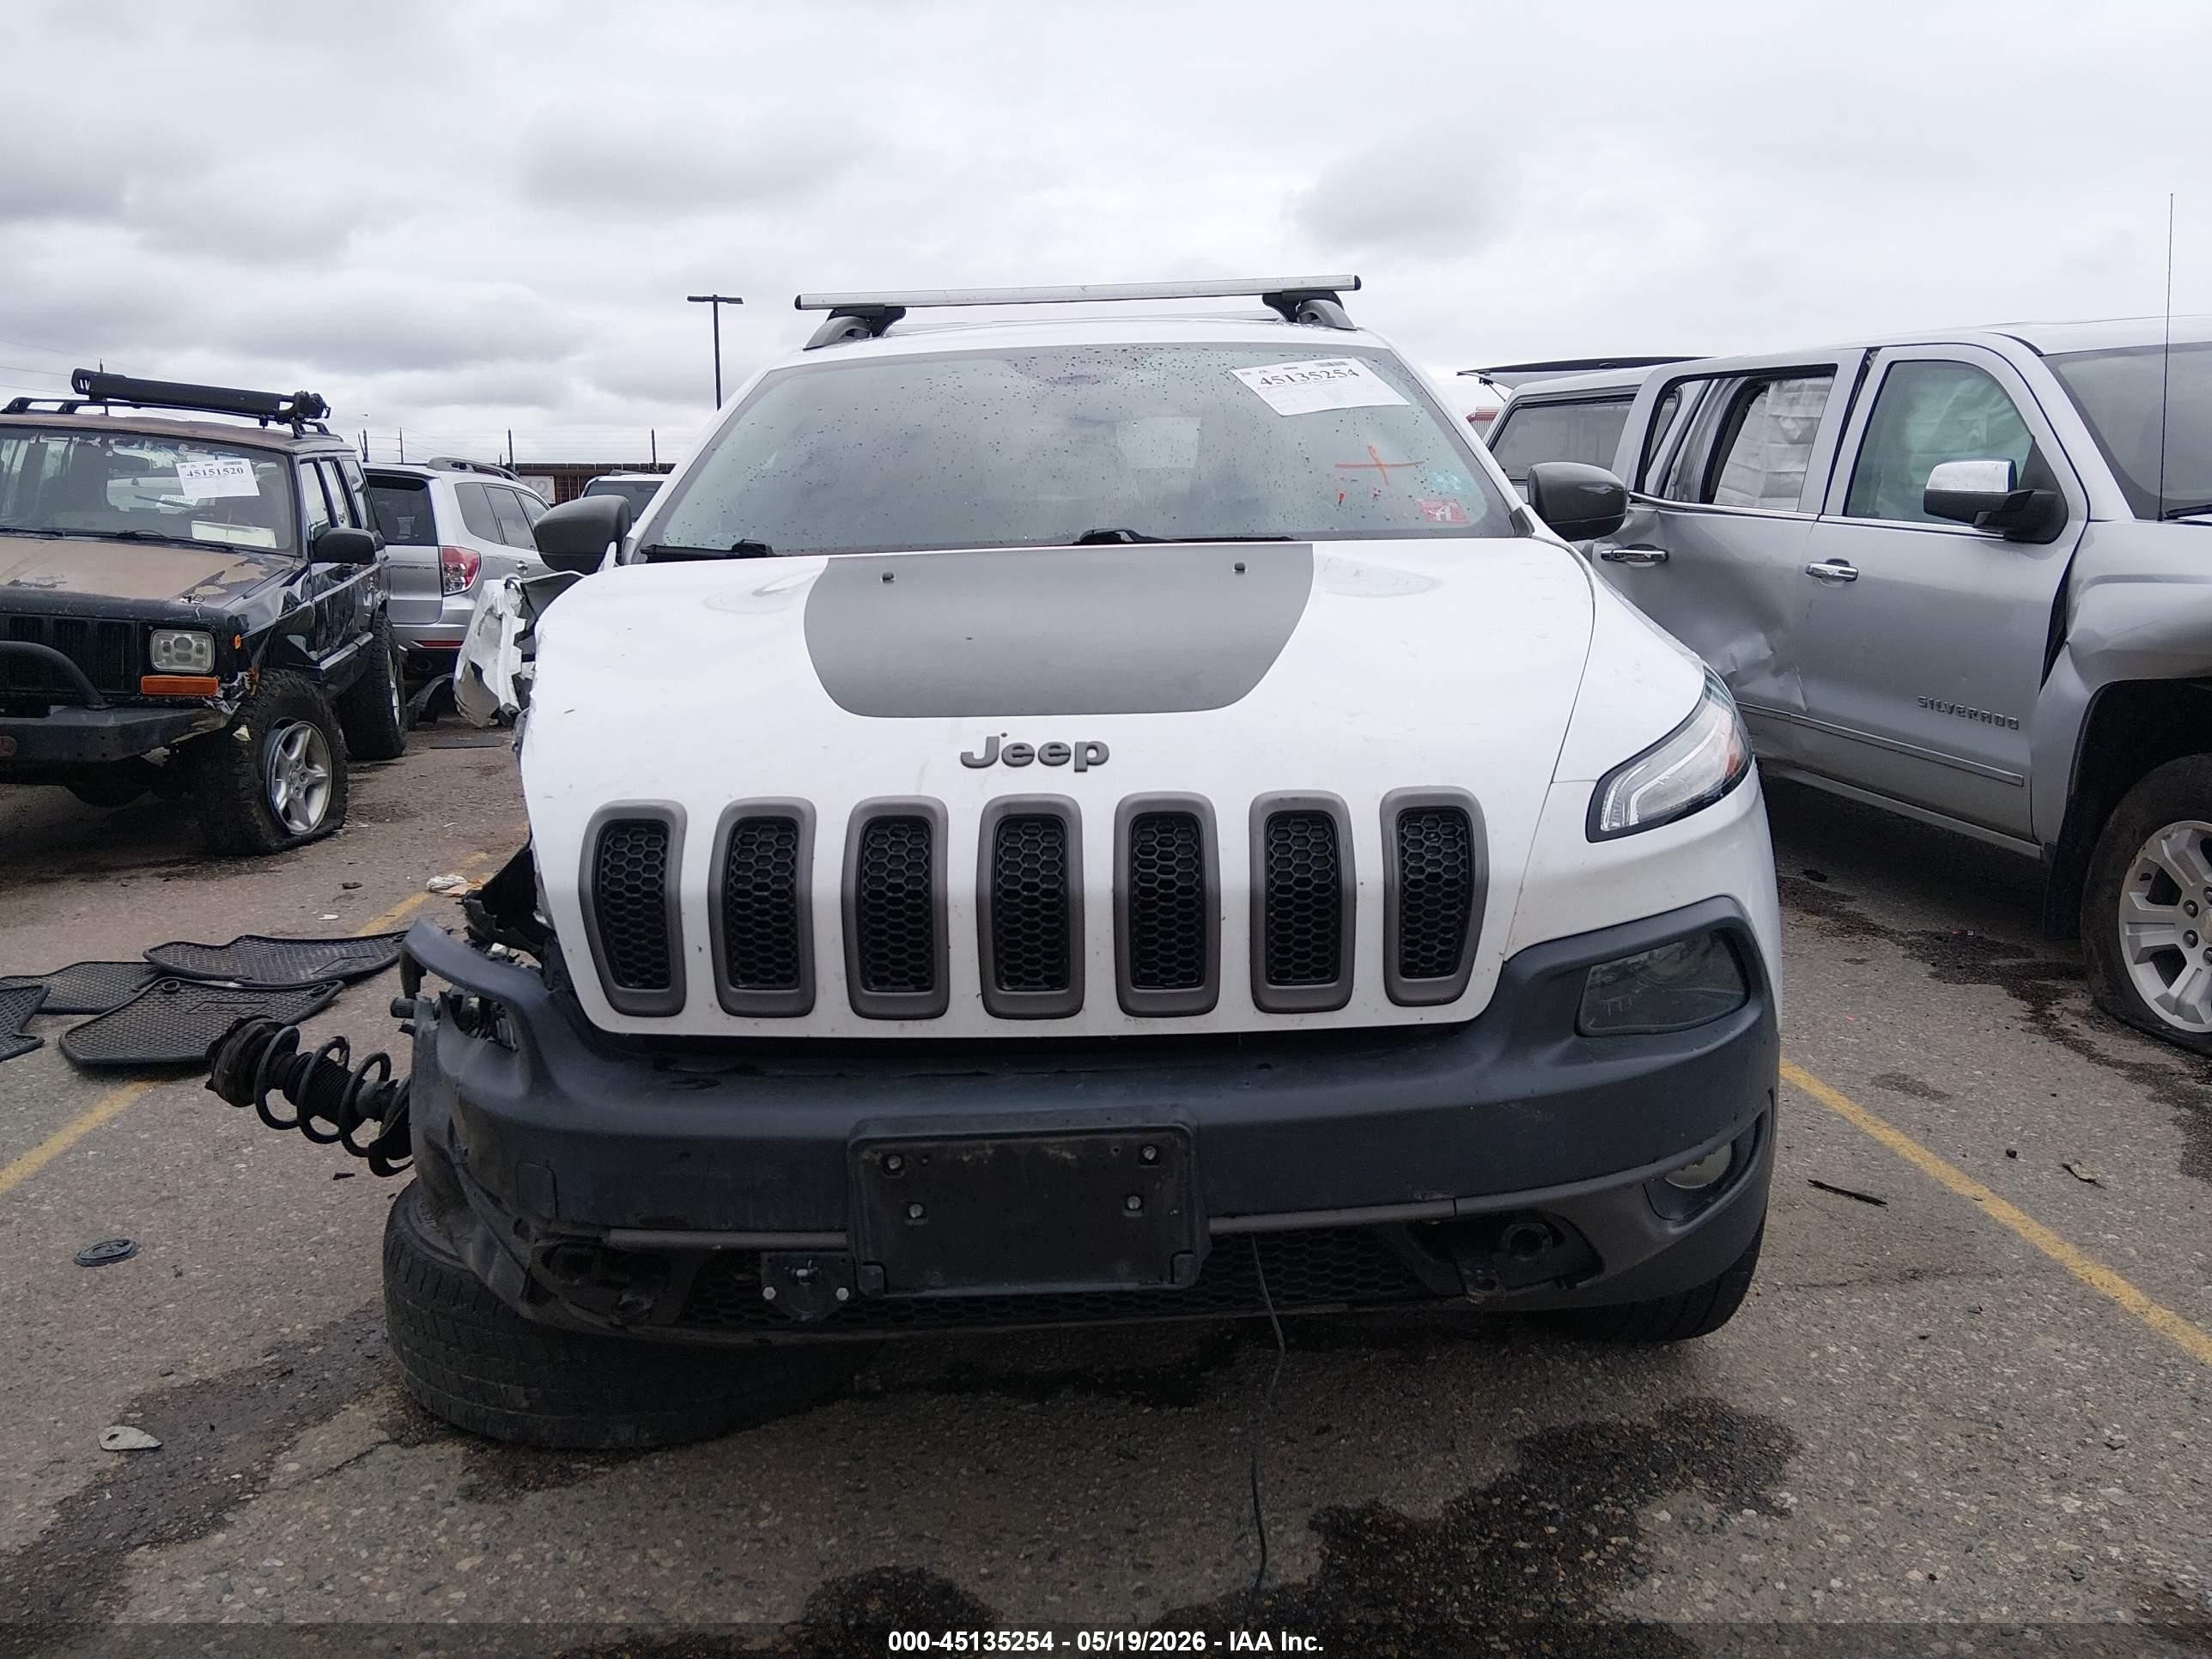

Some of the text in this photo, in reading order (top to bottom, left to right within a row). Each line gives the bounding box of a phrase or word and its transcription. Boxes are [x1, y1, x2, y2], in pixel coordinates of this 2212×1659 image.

[1260, 368, 1359, 386] 45135254
[186, 467, 244, 477] 45151520
[1917, 695, 2019, 730] SILVERADO
[960, 736, 1109, 773] Jeep
